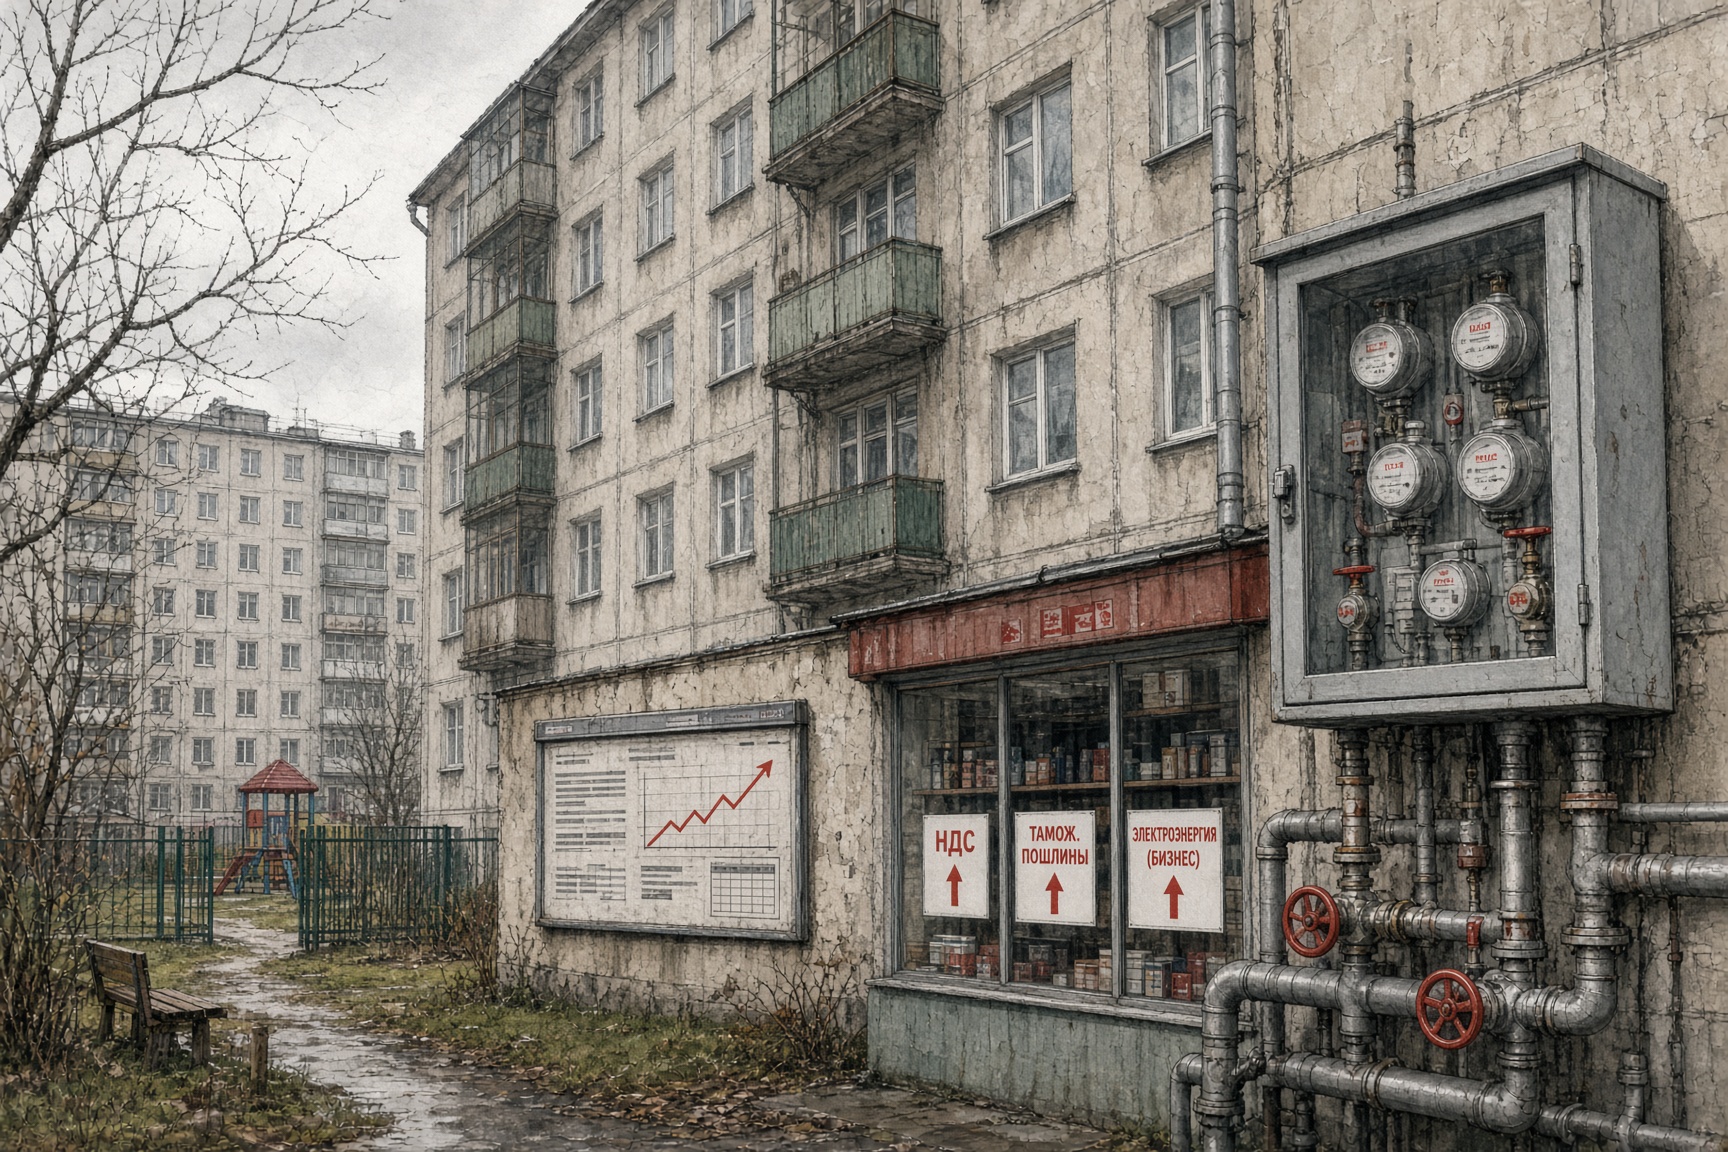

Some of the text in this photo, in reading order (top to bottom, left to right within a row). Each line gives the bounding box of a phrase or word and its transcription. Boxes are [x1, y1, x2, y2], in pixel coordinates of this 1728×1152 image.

[1029, 825, 1081, 842] ТАМОЖ.
[1132, 826, 1217, 843] ЭЛЕКТРОЭНЕРГИЯ
[935, 829, 975, 857] НДС
[1021, 847, 1089, 865] ПОШЛИНЫ
[1147, 849, 1201, 869] (БИЗНЕС)
